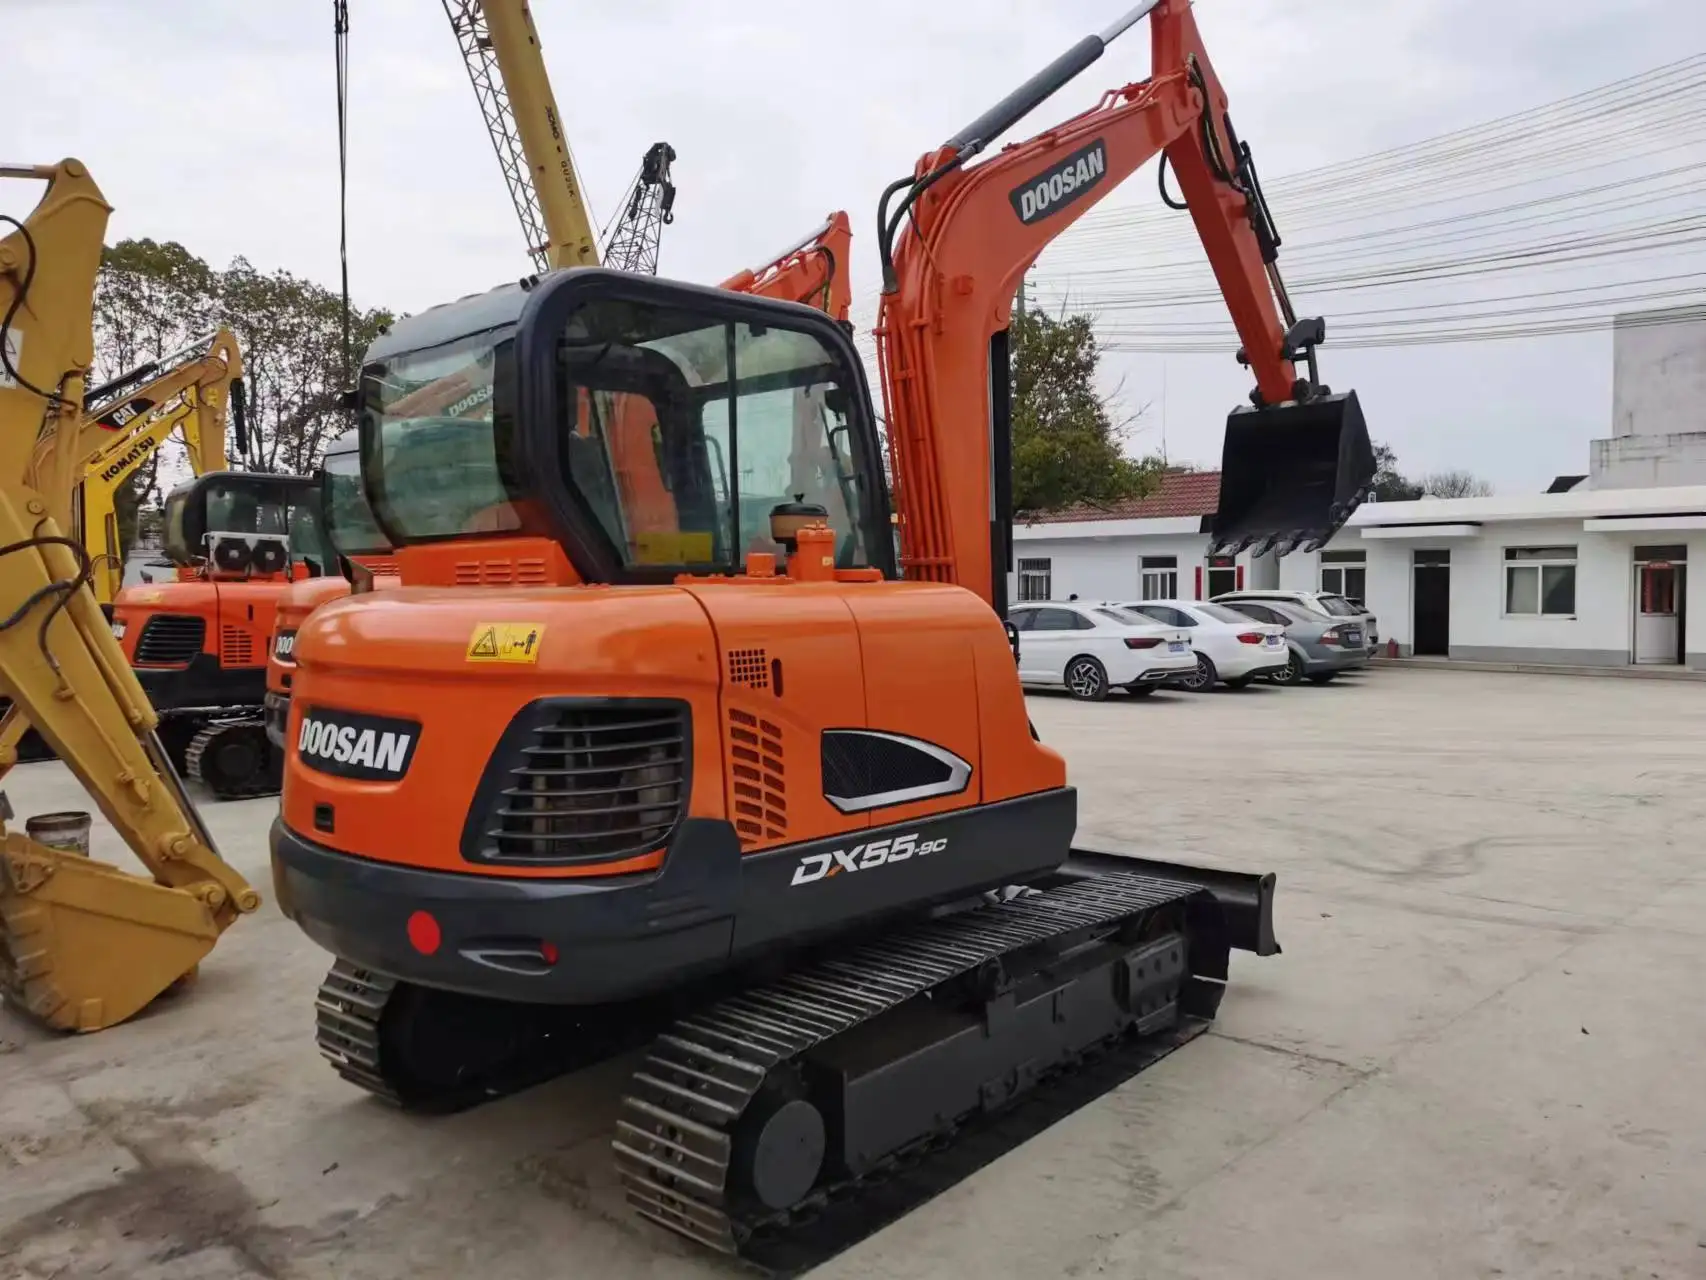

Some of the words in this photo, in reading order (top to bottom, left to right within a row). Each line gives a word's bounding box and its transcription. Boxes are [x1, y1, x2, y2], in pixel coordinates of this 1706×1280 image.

[1021, 147, 1104, 221] DOOSAN
[113, 403, 138, 426] CAT
[101, 436, 155, 482] KOMATSU
[299, 718, 411, 772] DOOSAN
